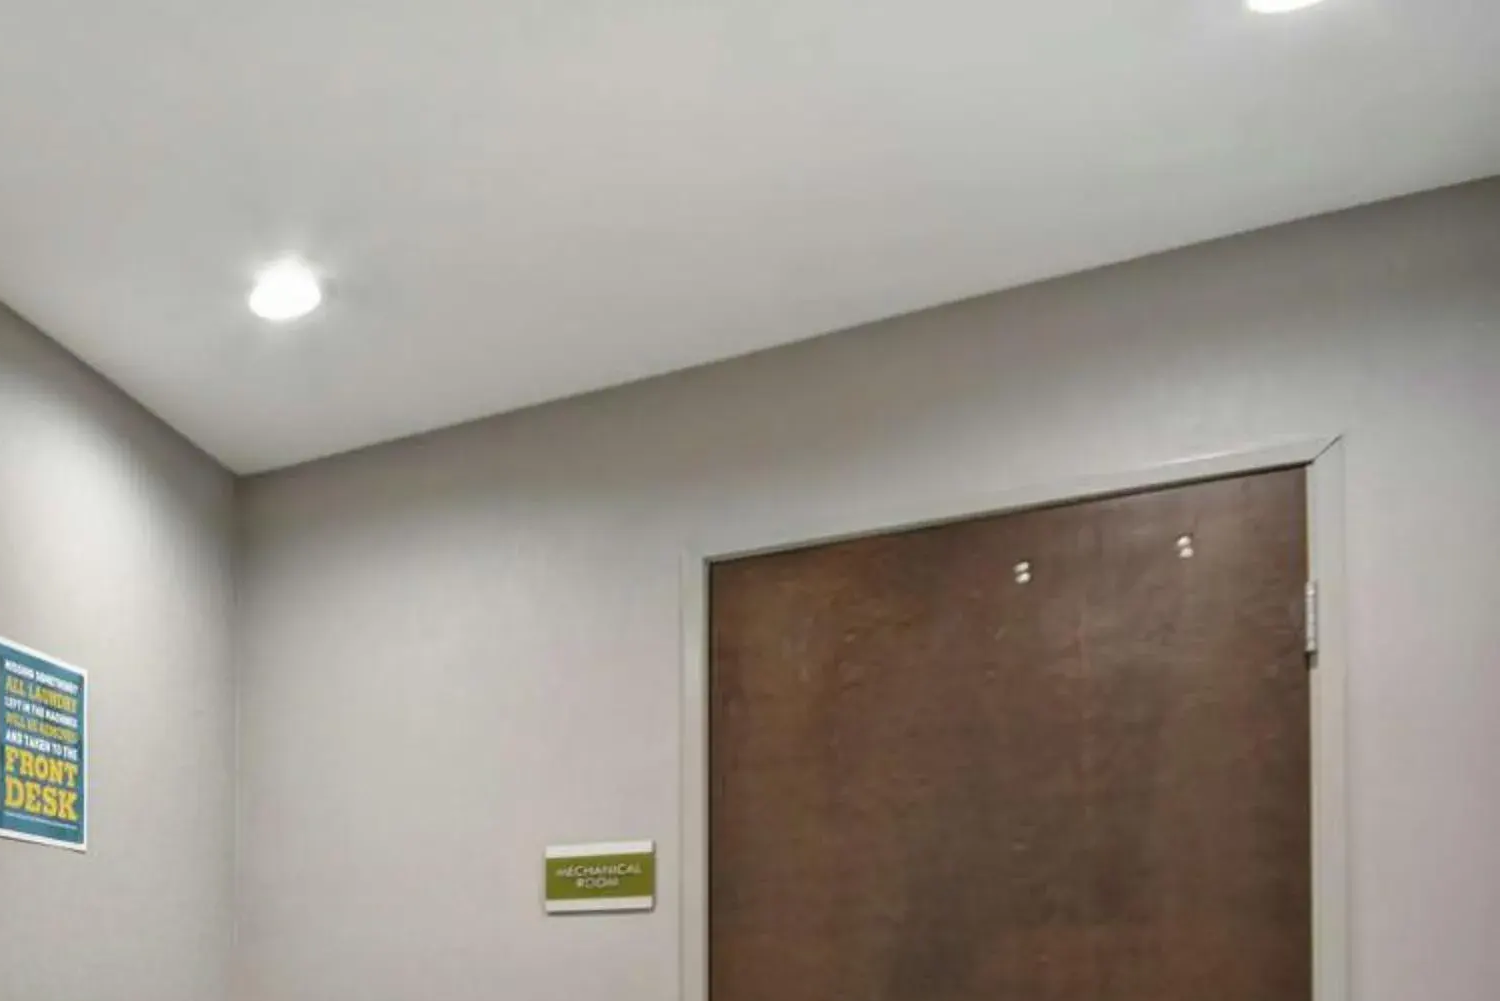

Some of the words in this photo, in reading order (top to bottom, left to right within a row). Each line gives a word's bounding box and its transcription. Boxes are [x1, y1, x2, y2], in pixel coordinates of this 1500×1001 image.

[4, 744, 78, 787] FRONT
[4, 776, 78, 823] DESK
[576, 877, 620, 890] ROOM
